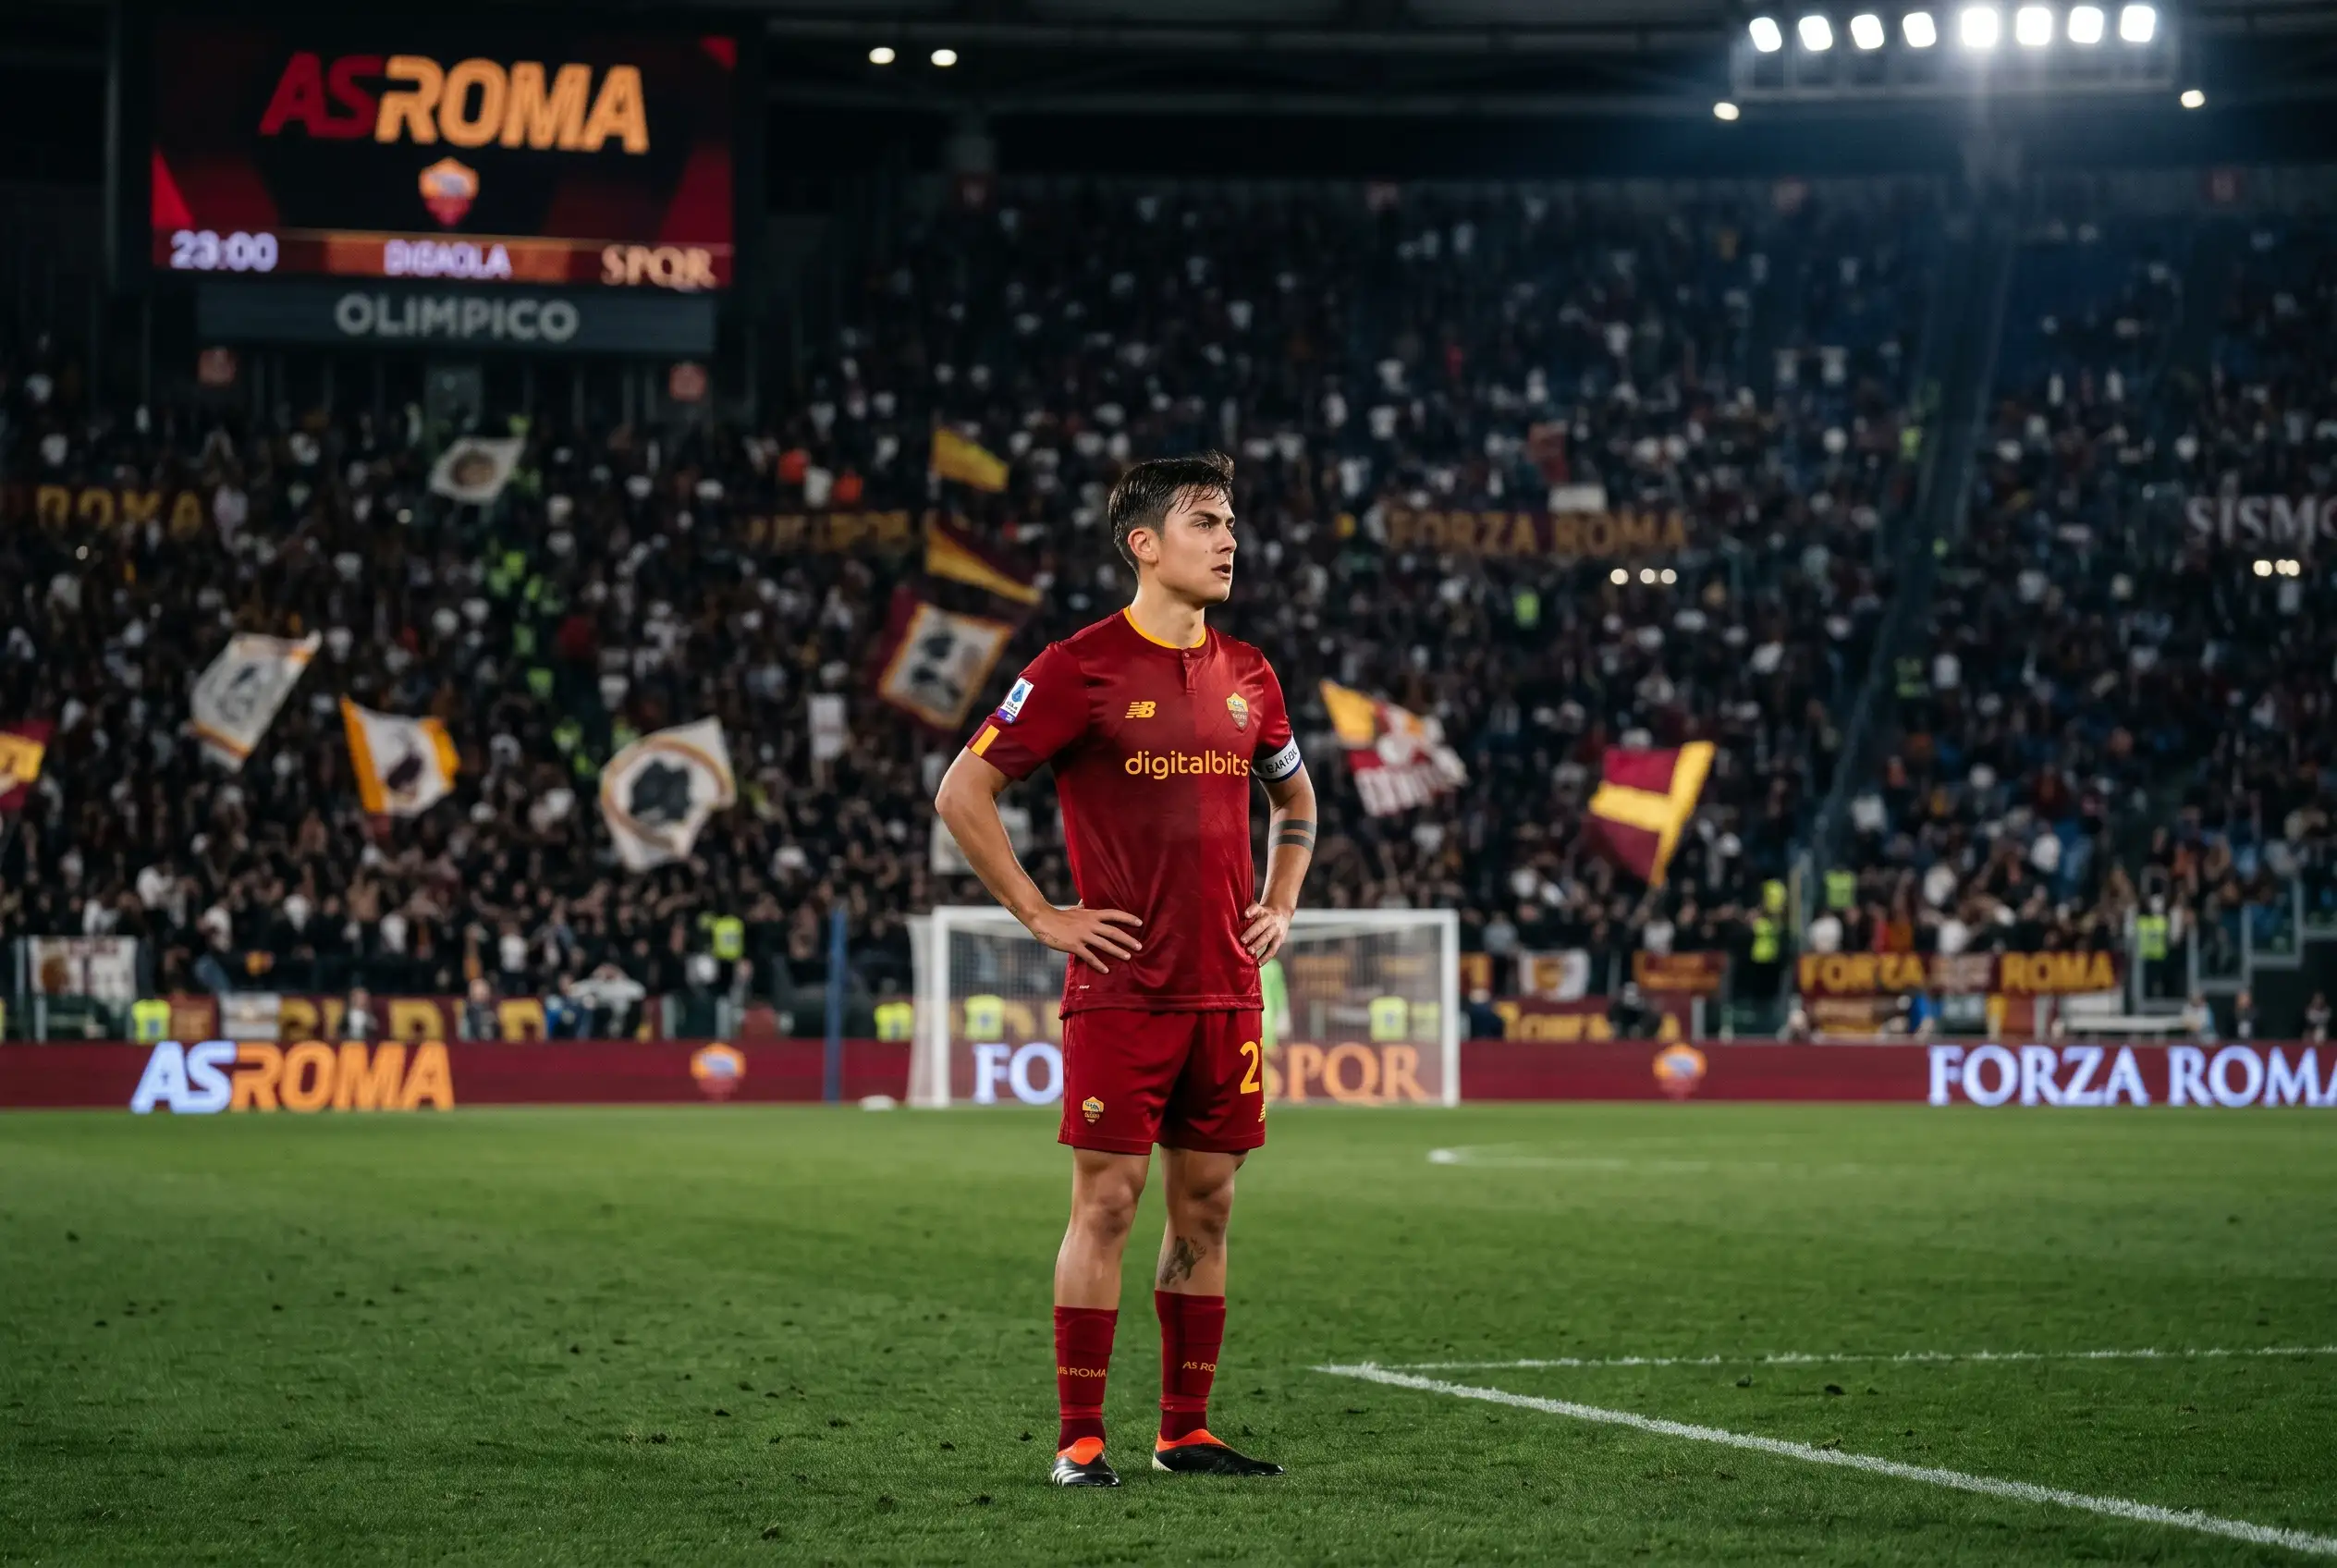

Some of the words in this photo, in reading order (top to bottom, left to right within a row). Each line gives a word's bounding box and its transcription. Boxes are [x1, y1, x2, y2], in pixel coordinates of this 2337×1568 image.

[602, 244, 718, 292] SPQR
[334, 291, 581, 342] OLIMPICO
[1125, 750, 1250, 780] digitalbits
[2000, 950, 2114, 994] ROMA
[1240, 1037, 1264, 1095] 2
[1928, 1044, 2150, 1108] FORZA
[1069, 1367, 1107, 1378] ROMA
[1182, 1361, 1197, 1369] AS
